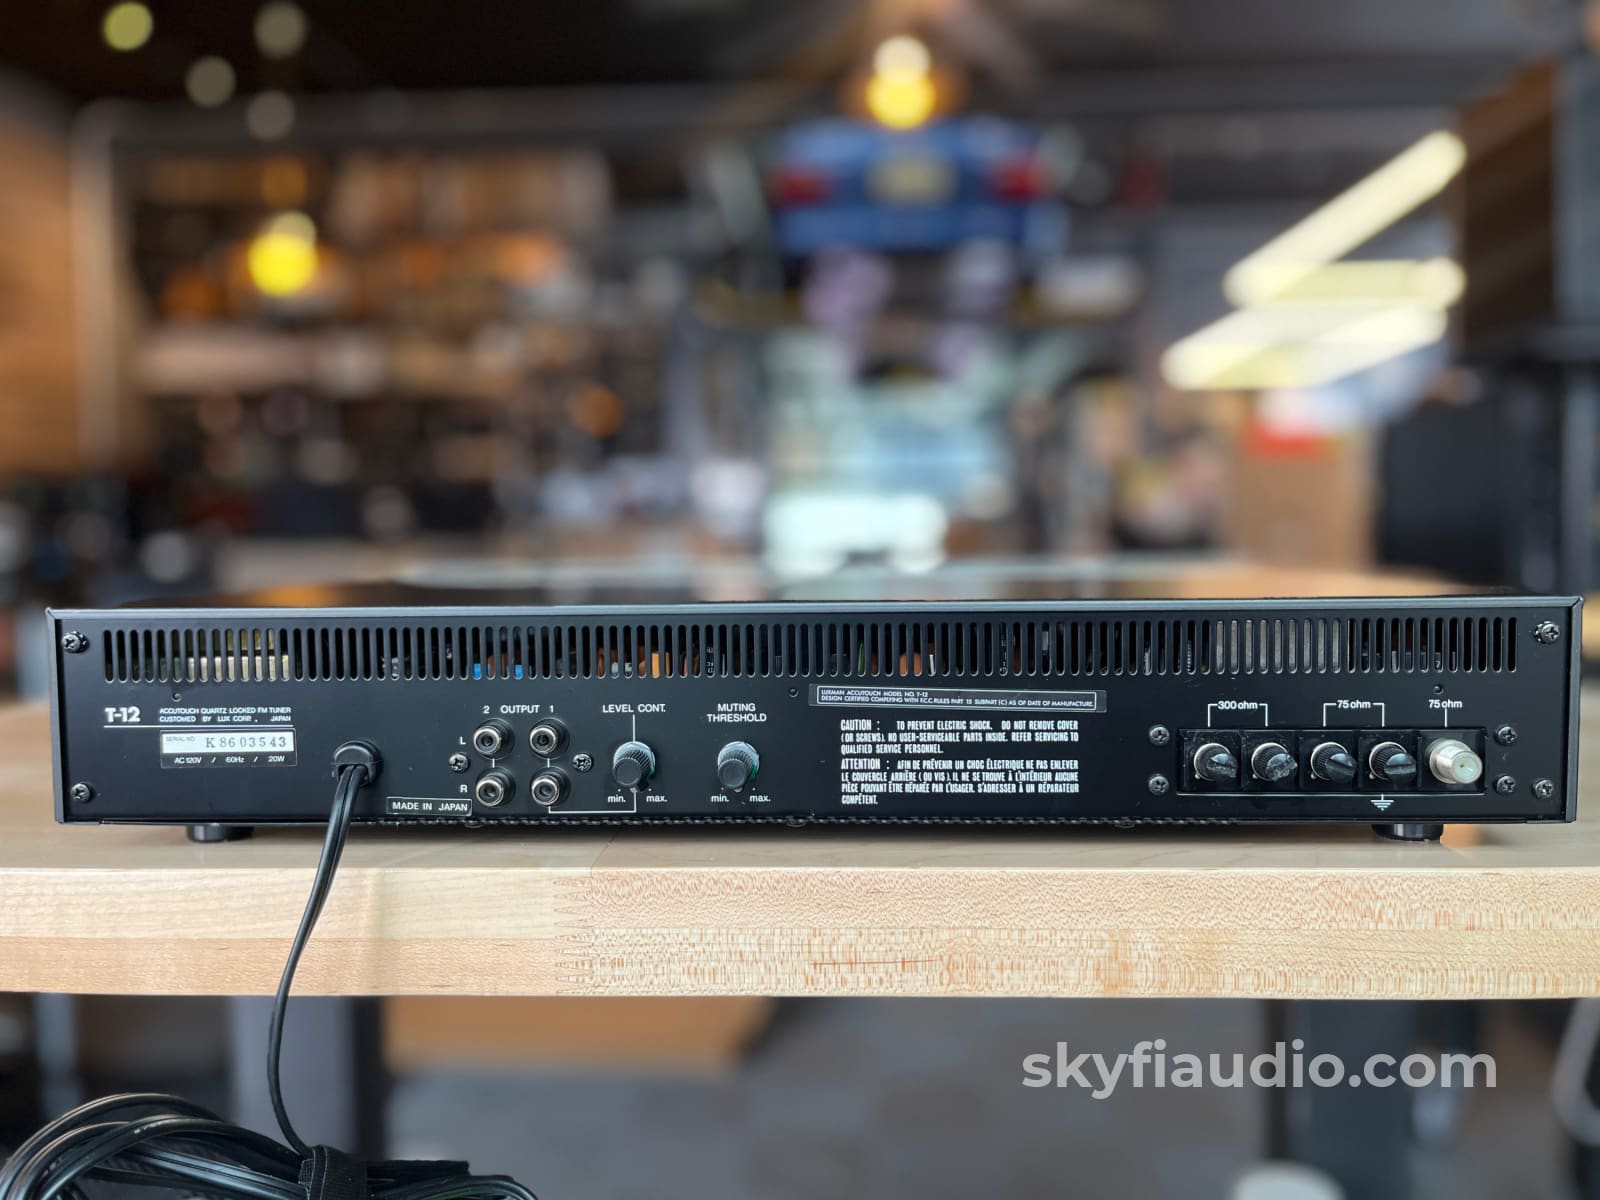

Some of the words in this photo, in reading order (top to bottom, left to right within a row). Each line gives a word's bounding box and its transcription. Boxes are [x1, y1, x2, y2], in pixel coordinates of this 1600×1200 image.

[602, 704, 634, 713] LEVEL
[637, 703, 666, 713] CONT.
[717, 703, 756, 712] MUTING
[1217, 700, 1238, 710] 300
[1237, 700, 1258, 709] ohm
[1337, 700, 1350, 709] 75
[1350, 700, 1371, 709] ohm
[1428, 699, 1441, 708] 75
[1441, 699, 1463, 708] ohm
[229, 706, 257, 714] LOCKED
[483, 705, 490, 714] 2
[500, 704, 540, 714] OUTPUT
[549, 705, 555, 713] 1
[104, 706, 141, 723] T-12
[706, 713, 768, 723] THRESHOLD
[840, 719, 872, 731] CAUTION
[896, 720, 905, 730] TO
[907, 720, 935, 730] PREVENT
[937, 720, 967, 730] ELECTRIC
[1001, 720, 1011, 730] DO
[1013, 720, 1026, 730] NOT
[1028, 720, 1055, 730] REMOVE
[1056, 720, 1079, 730] COVER
[459, 736, 466, 745] L
[887, 732, 897, 743] NO
[899, 732, 960, 743] USER-SERVICEABLE
[963, 732, 983, 742] PARTS
[1011, 732, 1032, 742] REFER
[1034, 732, 1069, 742] SERVICING
[1070, 732, 1079, 742] TO
[840, 743, 873, 755] QUALIFIED
[875, 743, 902, 753] SERVICE
[185, 756, 202, 764] 120V
[225, 755, 245, 763] 60Hz
[841, 758, 881, 770] ATTENTION
[896, 760, 911, 770] AFIN
[912, 760, 921, 770] DE
[922, 758, 953, 770] PRÉVENIR
[954, 760, 965, 770] UN
[966, 760, 985, 770] CHOC
[986, 758, 1025, 771] ÉLECTRIQUE
[1025, 760, 1035, 770] NE
[1036, 760, 1048, 770] PAS
[1050, 760, 1079, 770] ENLEVER
[841, 772, 849, 782] LE
[851, 772, 888, 782] COUVERCLE
[952, 772, 960, 782] IL
[961, 772, 971, 782] NE
[972, 772, 981, 782] SE
[982, 772, 1006, 782] TROUVE
[1054, 772, 1079, 782] AUCUNE
[459, 785, 468, 793] R
[860, 783, 888, 793] POUVANT
[931, 783, 944, 793] PAR
[1025, 783, 1036, 793] UN
[1038, 781, 1080, 793] RÉPARATEUR
[607, 794, 627, 803] min.
[711, 794, 730, 803] min.
[750, 795, 771, 803] max.
[392, 801, 419, 811] MADE
[422, 802, 433, 811] IN
[438, 803, 468, 812] JAPAN
